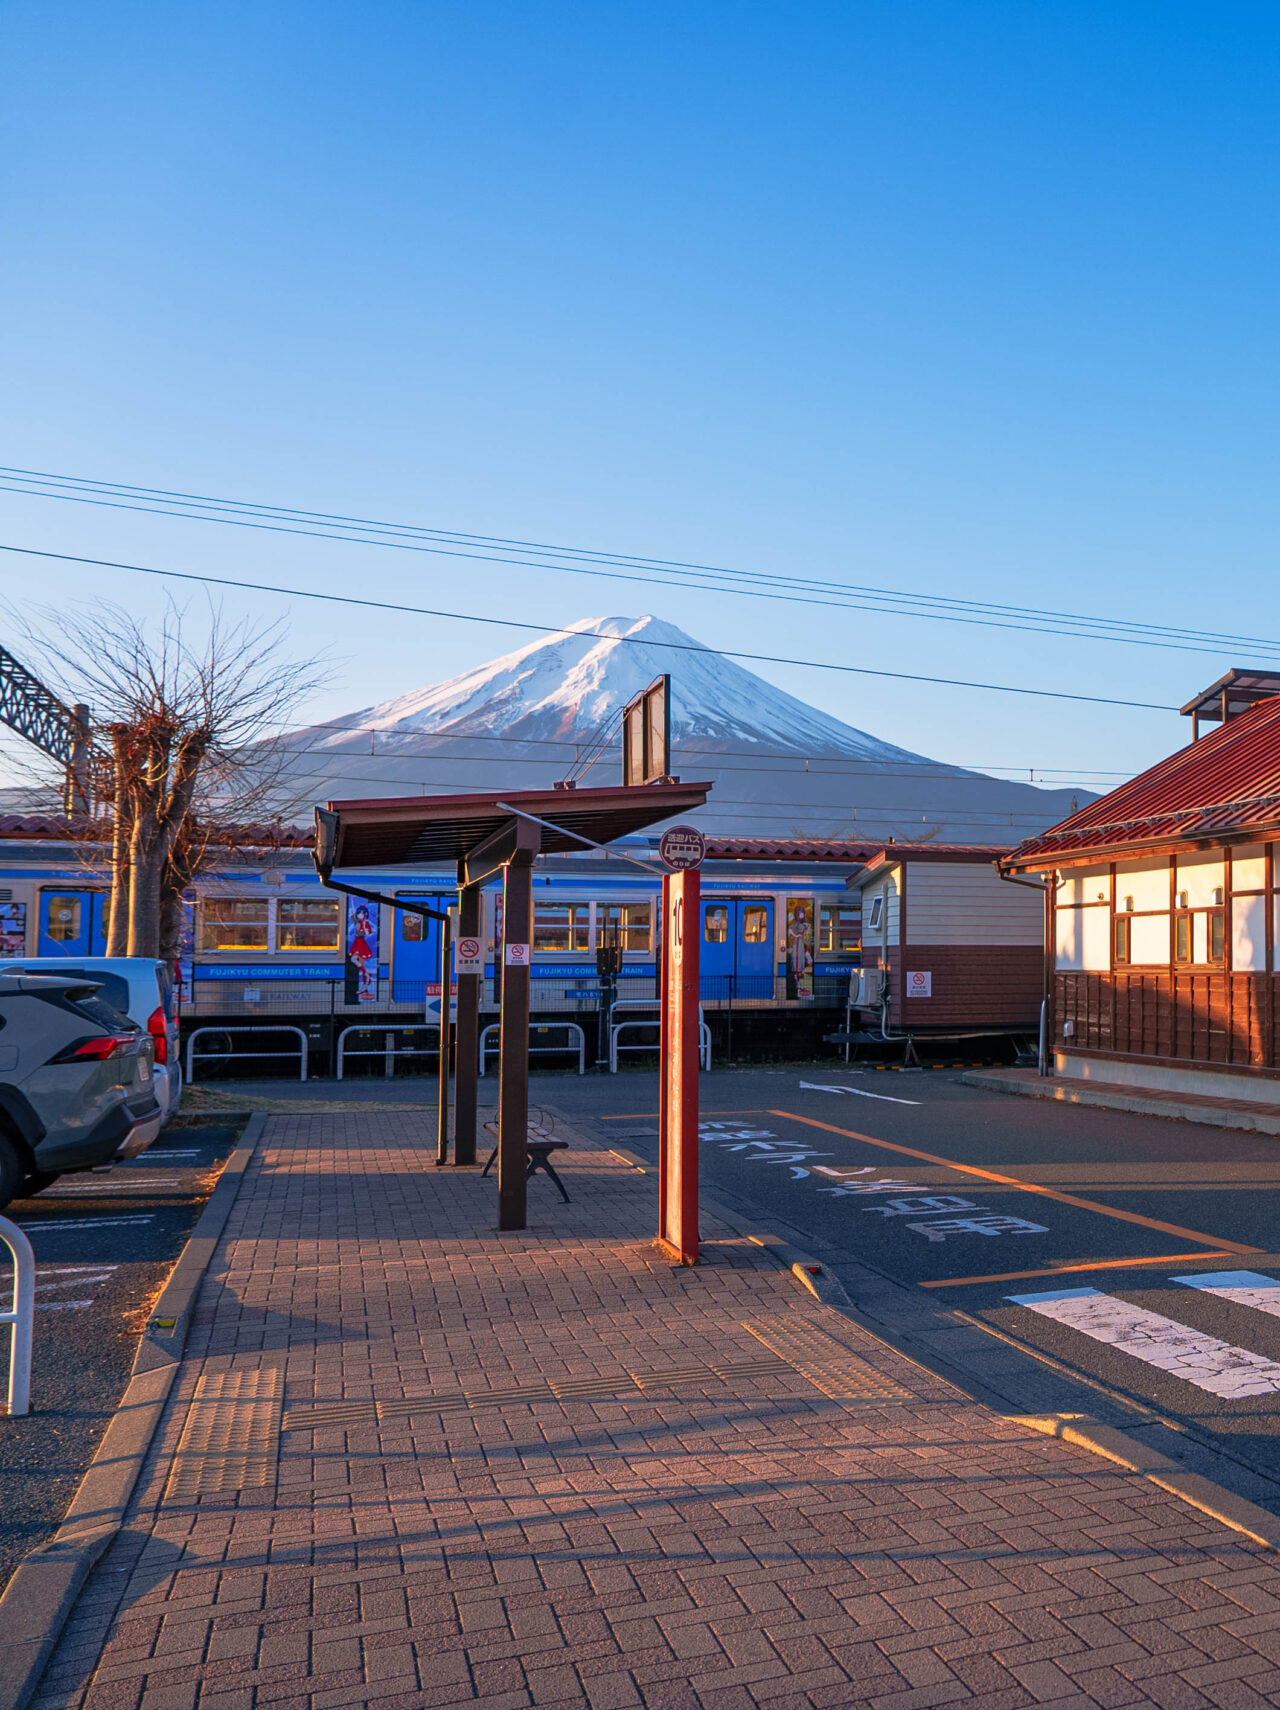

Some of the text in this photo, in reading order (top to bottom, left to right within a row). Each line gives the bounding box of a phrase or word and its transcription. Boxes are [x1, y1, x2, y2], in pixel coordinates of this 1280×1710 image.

[667, 833, 700, 844] 送迎バス
[209, 968, 331, 976] FUJIKYU COMMUTER TRAIN
[539, 967, 573, 975] FUJIKYU
